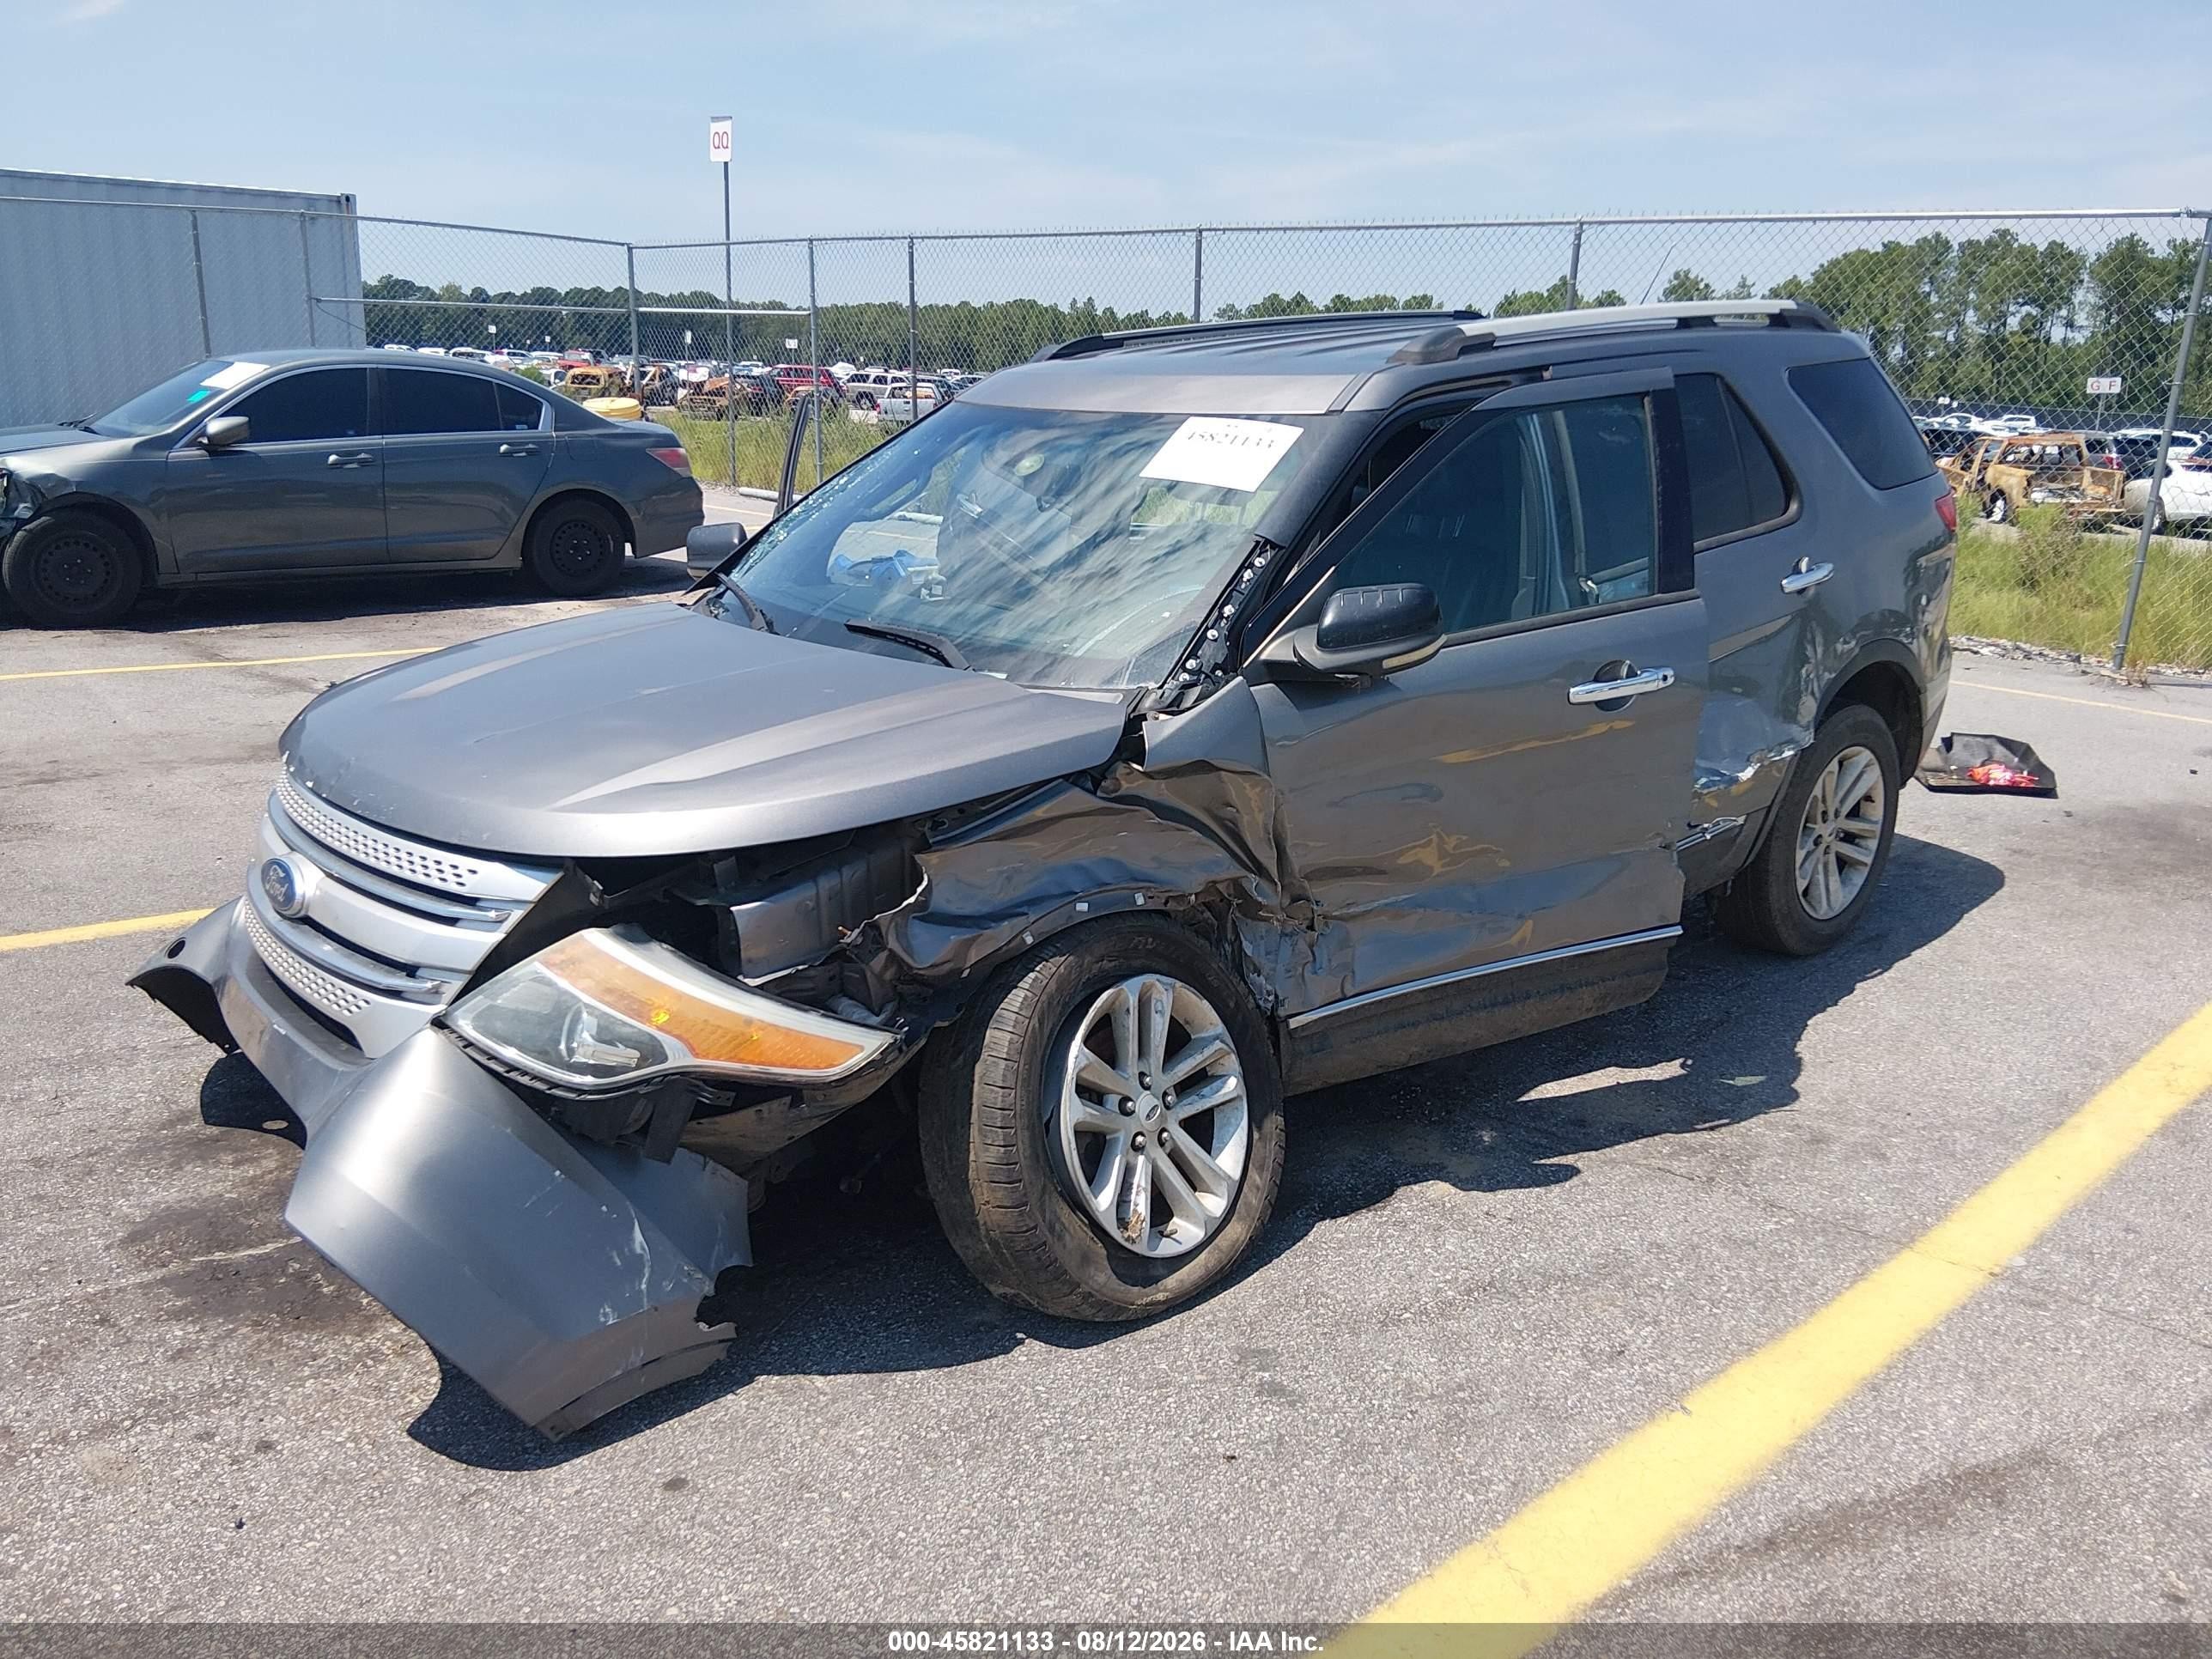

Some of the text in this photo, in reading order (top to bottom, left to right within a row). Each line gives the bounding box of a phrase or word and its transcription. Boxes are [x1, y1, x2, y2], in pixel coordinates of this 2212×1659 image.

[713, 131, 729, 149] QQ
[2090, 380, 2117, 392] G F
[265, 865, 289, 902] Ford
